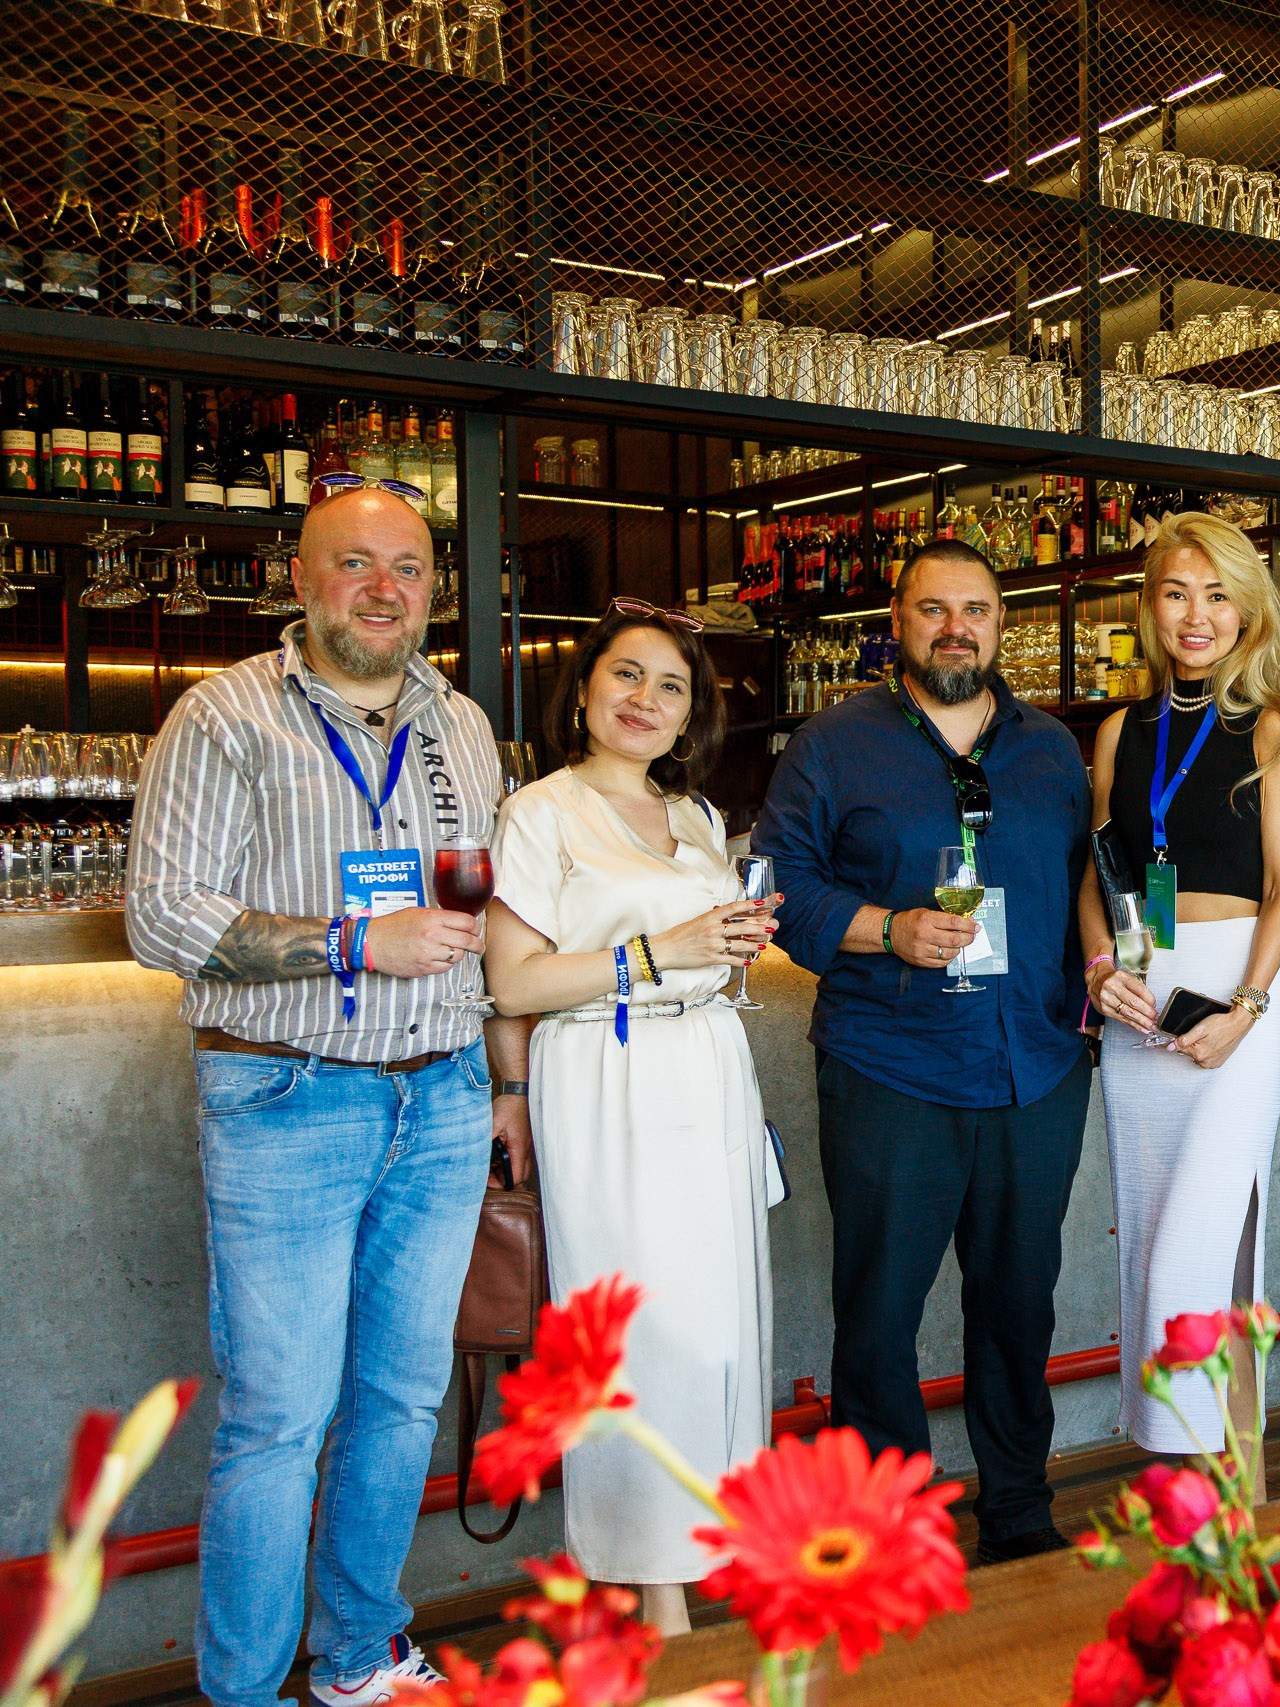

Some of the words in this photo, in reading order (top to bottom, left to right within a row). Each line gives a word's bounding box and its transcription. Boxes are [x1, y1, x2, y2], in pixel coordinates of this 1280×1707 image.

[347, 861, 417, 874] GASTREET
[358, 872, 409, 884] ПРОФИ
[328, 927, 344, 972] ПРОФИ
